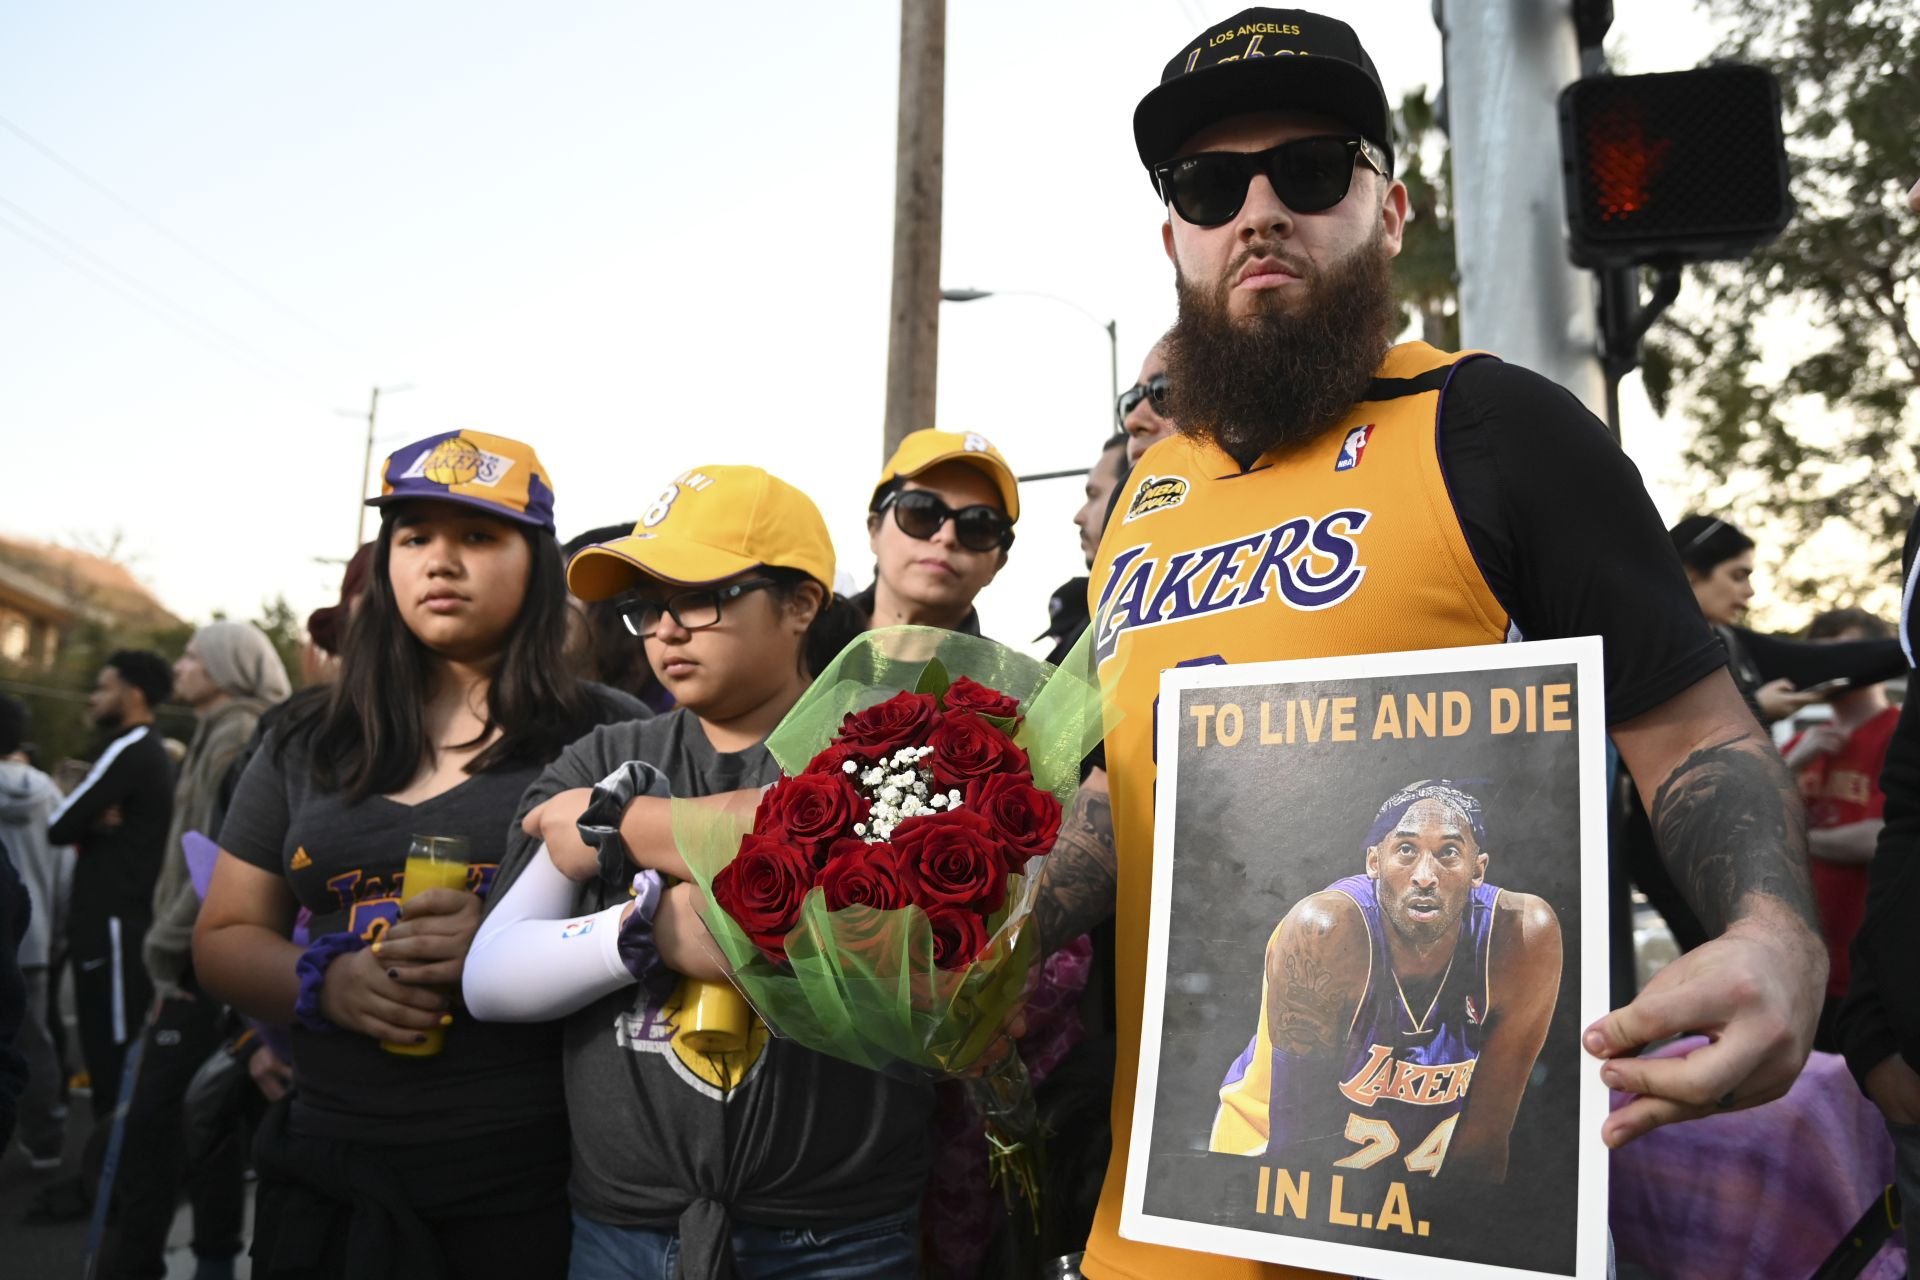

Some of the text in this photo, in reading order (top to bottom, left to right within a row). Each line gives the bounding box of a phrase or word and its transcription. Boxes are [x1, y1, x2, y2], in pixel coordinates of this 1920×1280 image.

[1209, 23, 1300, 47] LOS ANGELES
[1338, 458, 1352, 468] NBA
[642, 483, 680, 528] 8
[1095, 508, 1372, 664] LAKERS
[1189, 683, 1573, 748] TO LIVE AND DIE
[1338, 1043, 1476, 1107] LAKER
[1333, 1112, 1460, 1178] 24
[1255, 1166, 1430, 1237] IN L.A.
